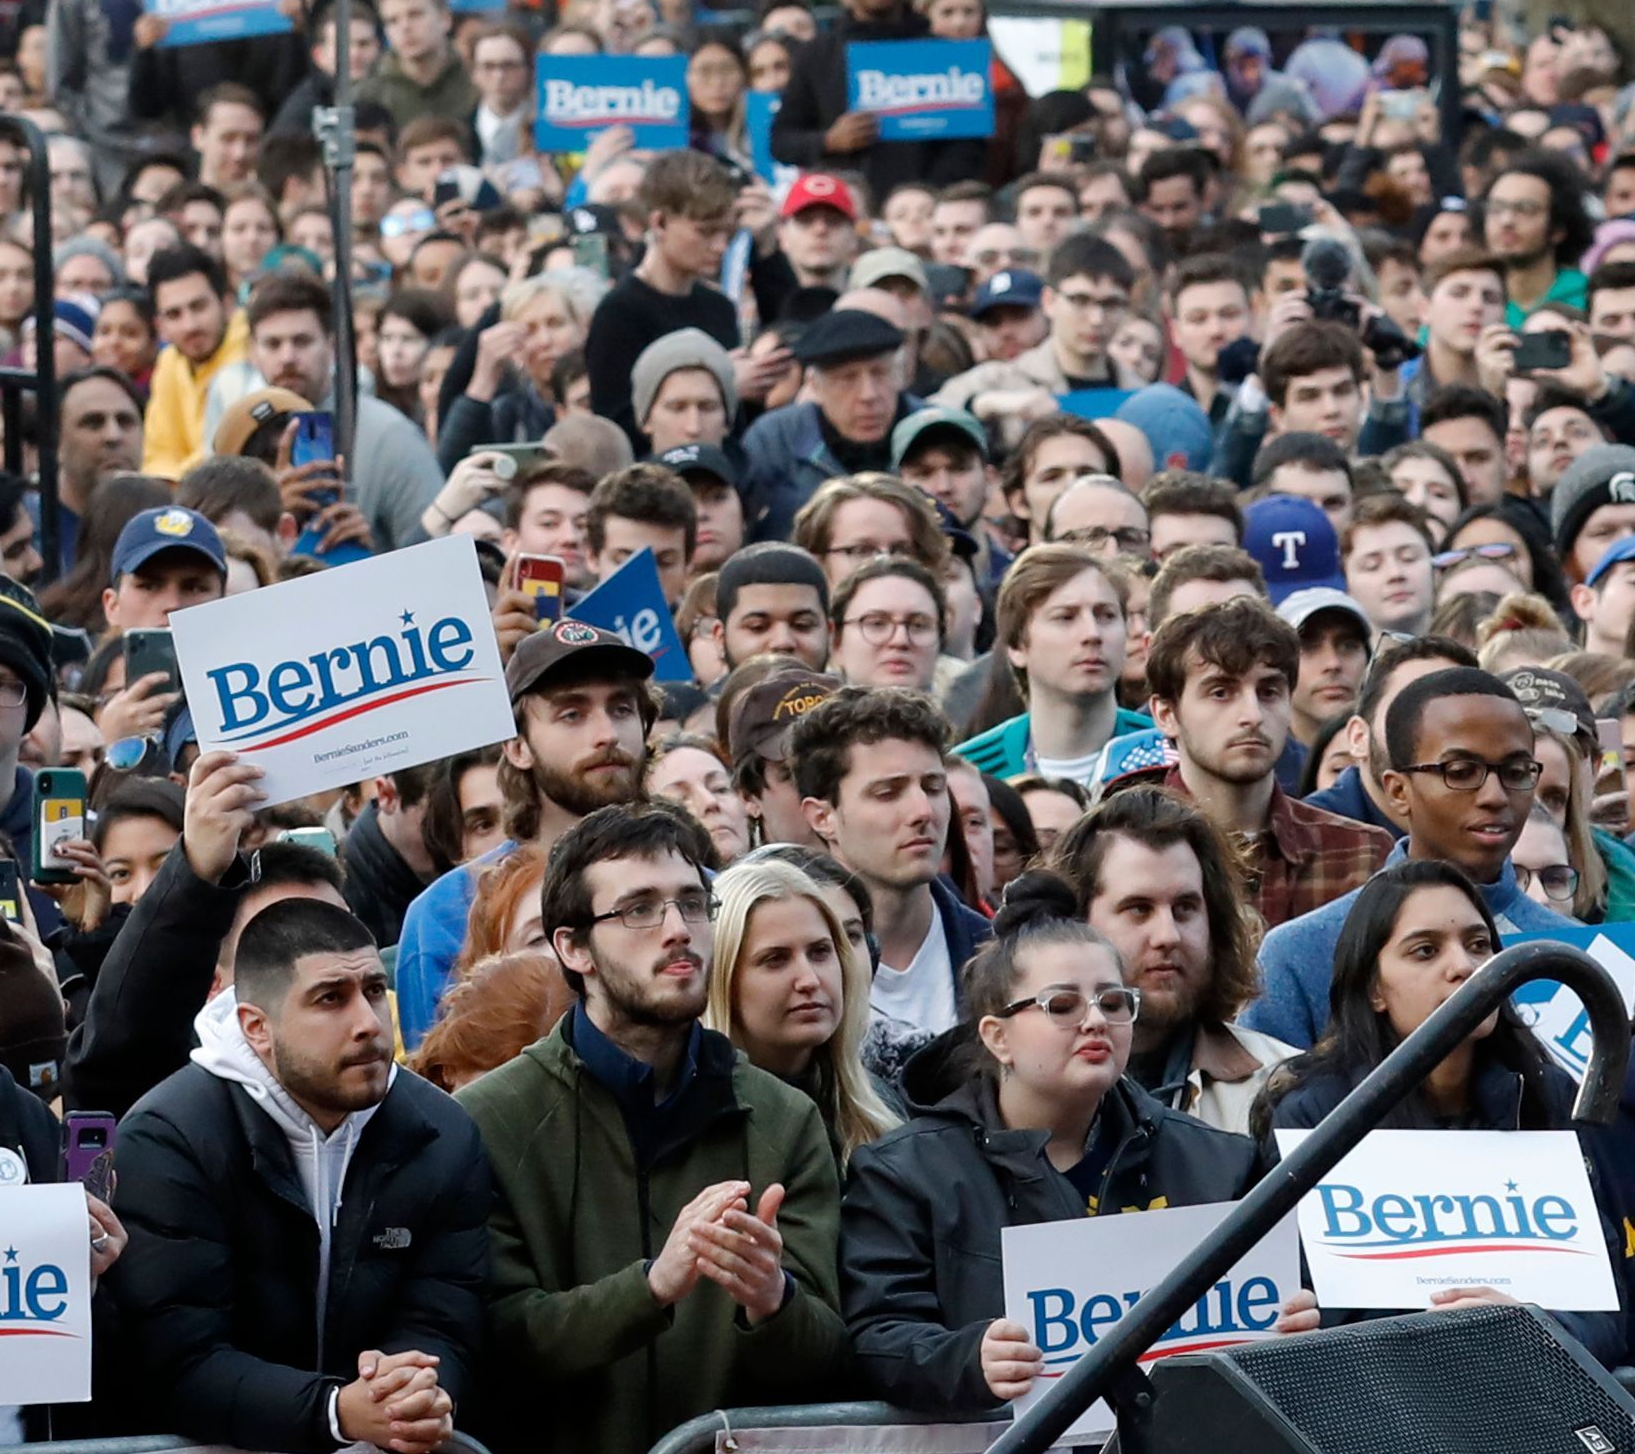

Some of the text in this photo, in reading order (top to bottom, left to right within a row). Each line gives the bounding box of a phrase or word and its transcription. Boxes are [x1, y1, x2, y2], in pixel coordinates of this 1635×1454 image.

[544, 79, 681, 120] Bernie
[857, 65, 985, 108] Bernie
[1272, 531, 1306, 569] T
[205, 607, 476, 734] Bernie
[312, 729, 410, 765] BernieSanders.com
[1315, 1178, 1578, 1239] Bernie
[1416, 1275, 1512, 1286] BernieSanders.com
